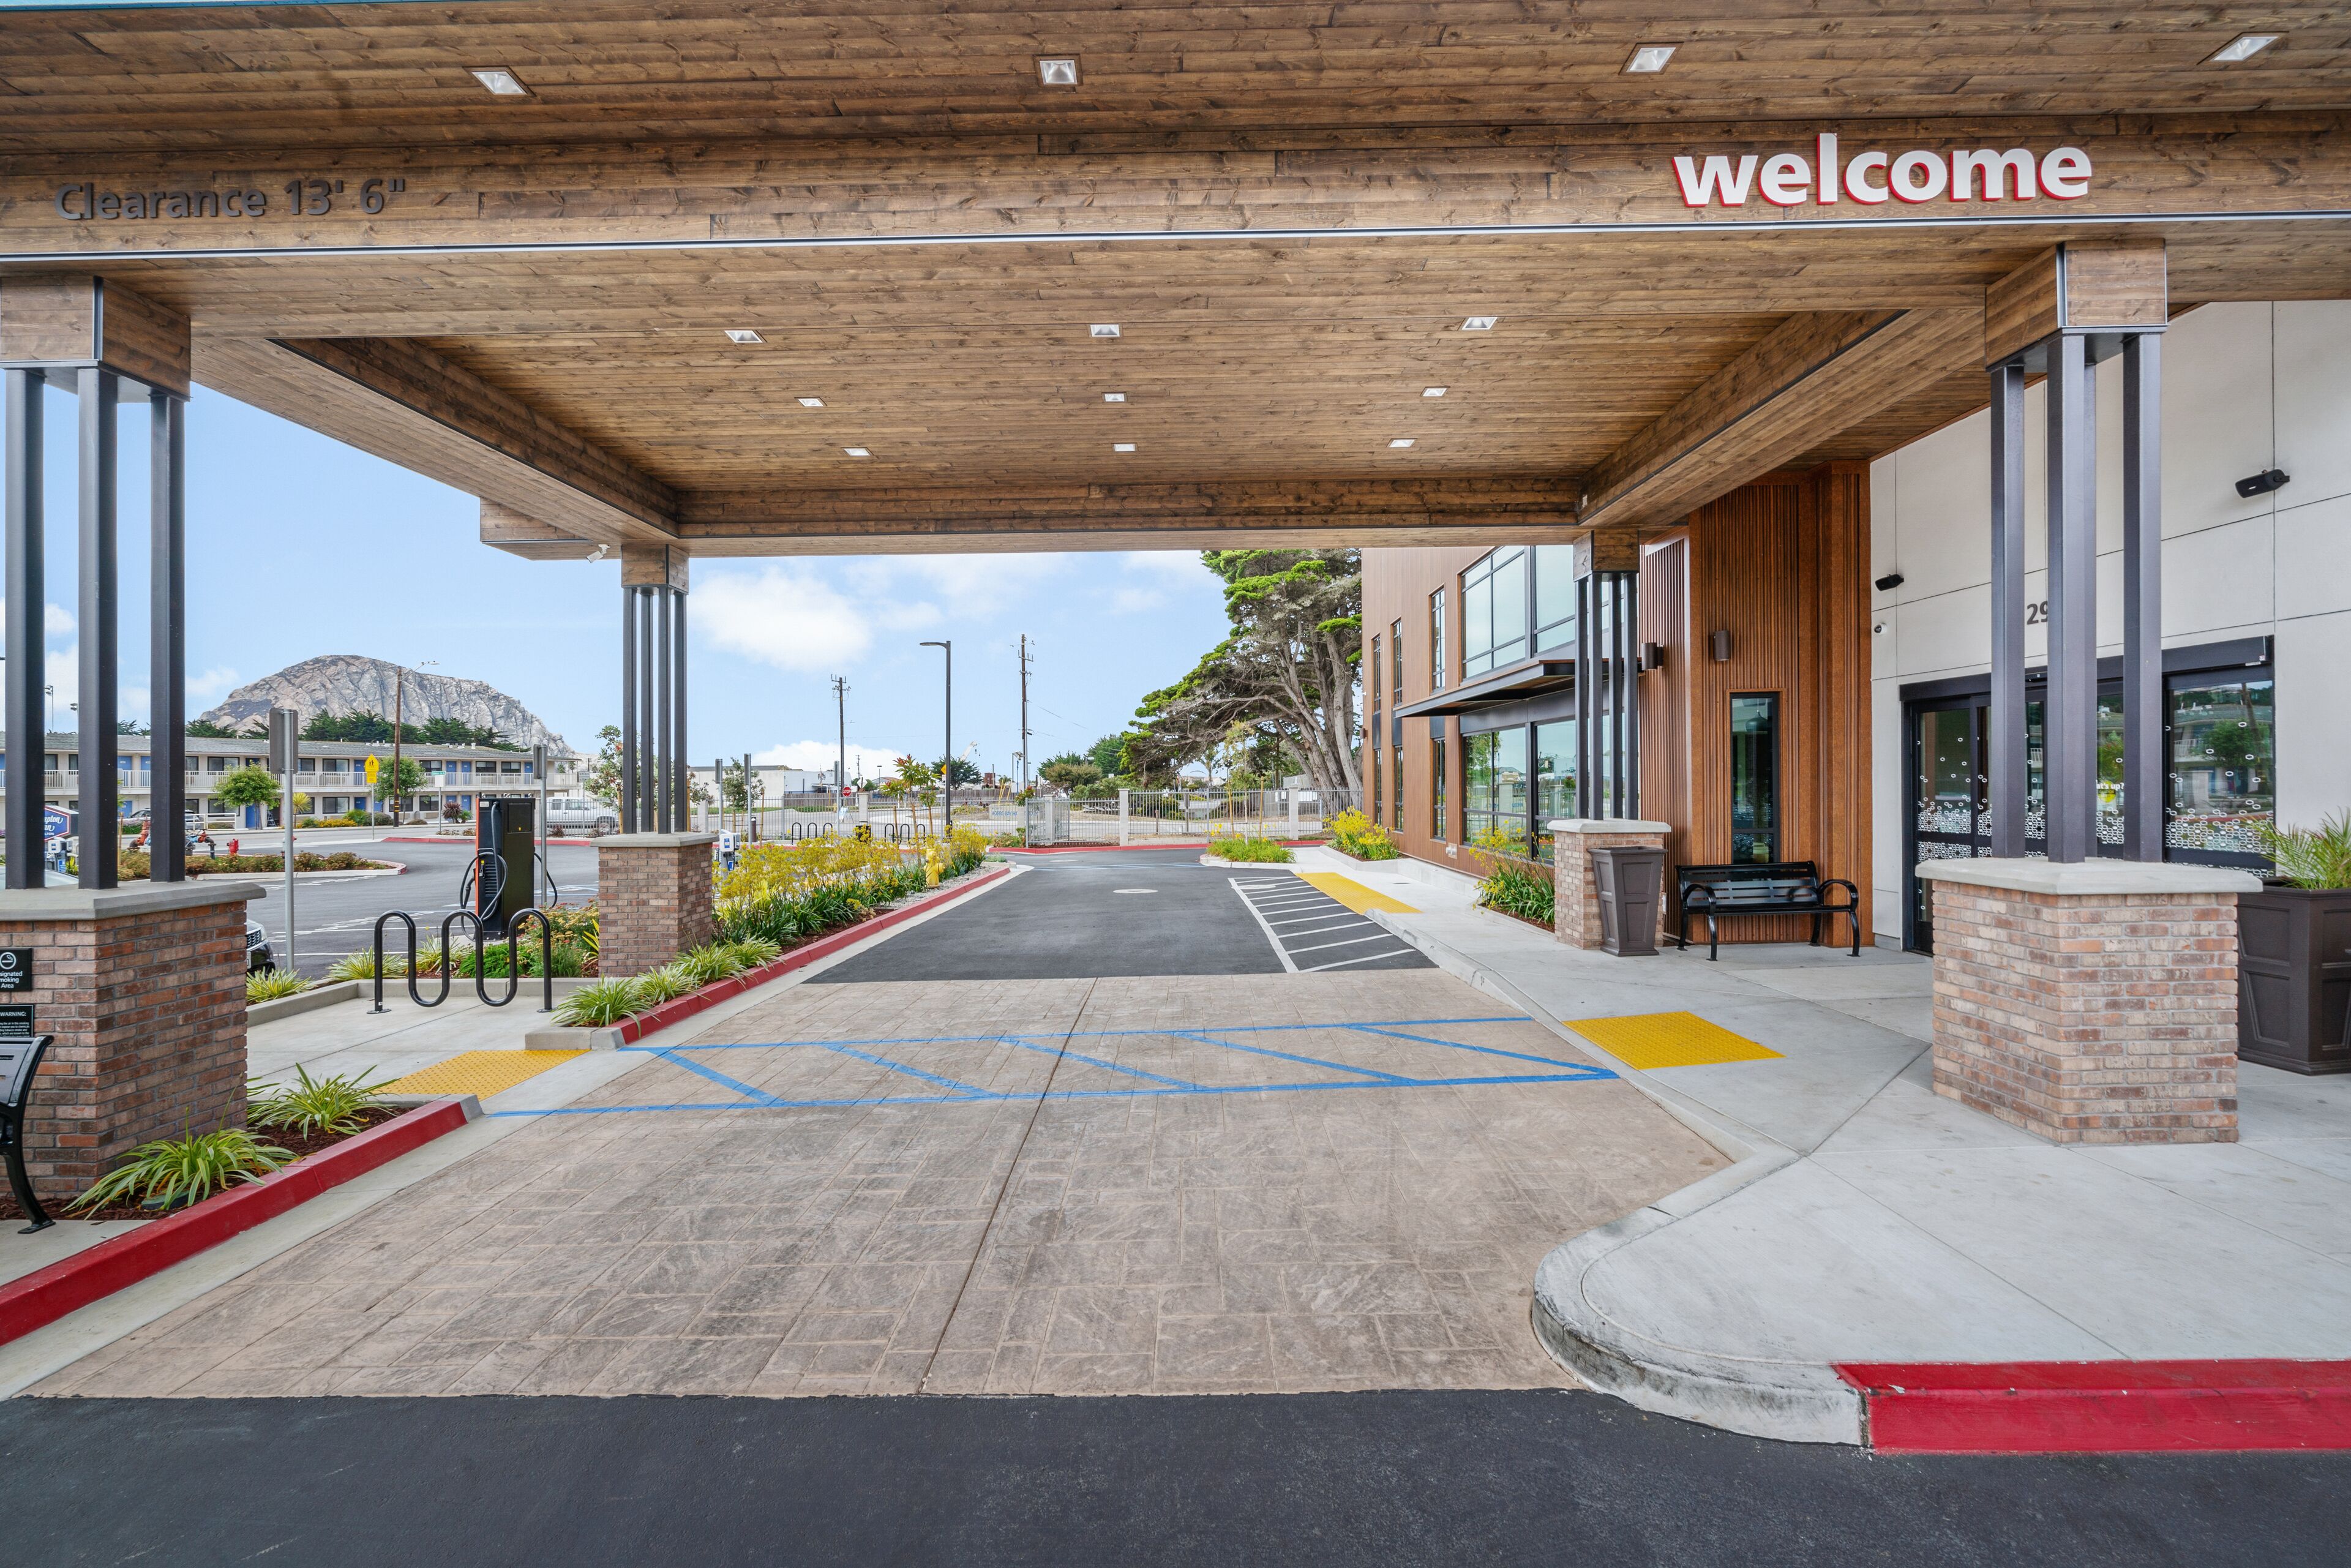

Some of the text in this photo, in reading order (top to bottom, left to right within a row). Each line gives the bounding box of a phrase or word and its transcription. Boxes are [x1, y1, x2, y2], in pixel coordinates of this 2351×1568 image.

[1671, 132, 2092, 207] welcome
[54, 178, 405, 220] Clearance 13' 6"
